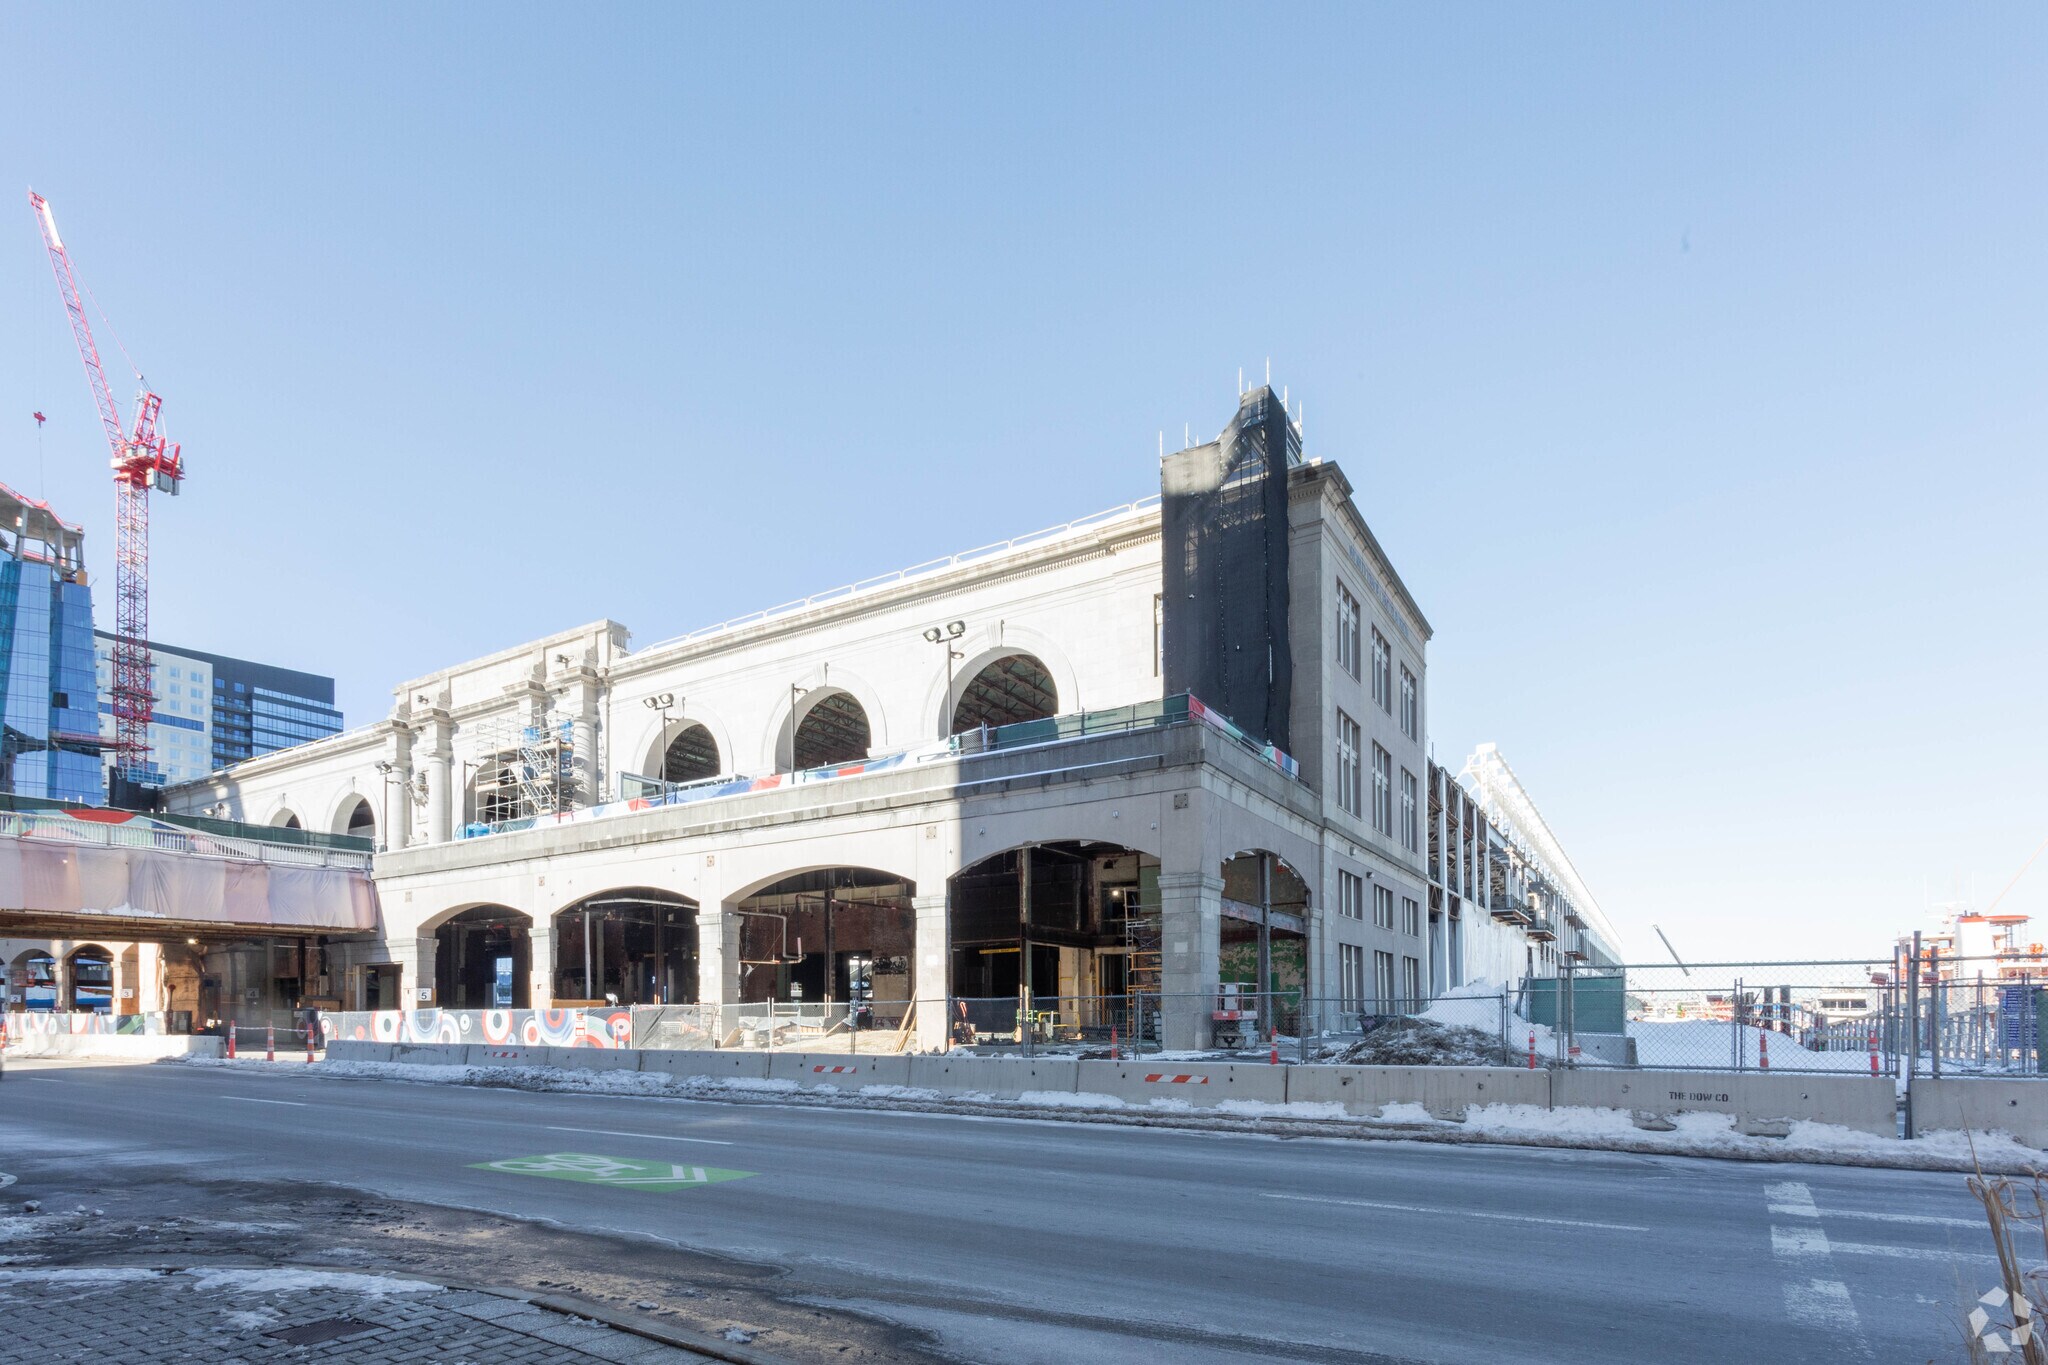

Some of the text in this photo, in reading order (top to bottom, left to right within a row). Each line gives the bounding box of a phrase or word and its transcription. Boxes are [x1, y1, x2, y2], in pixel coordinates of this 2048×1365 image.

[421, 992, 427, 1000] 5
[1669, 1091, 1686, 1100] THE
[1689, 1092, 1712, 1101] DOW
